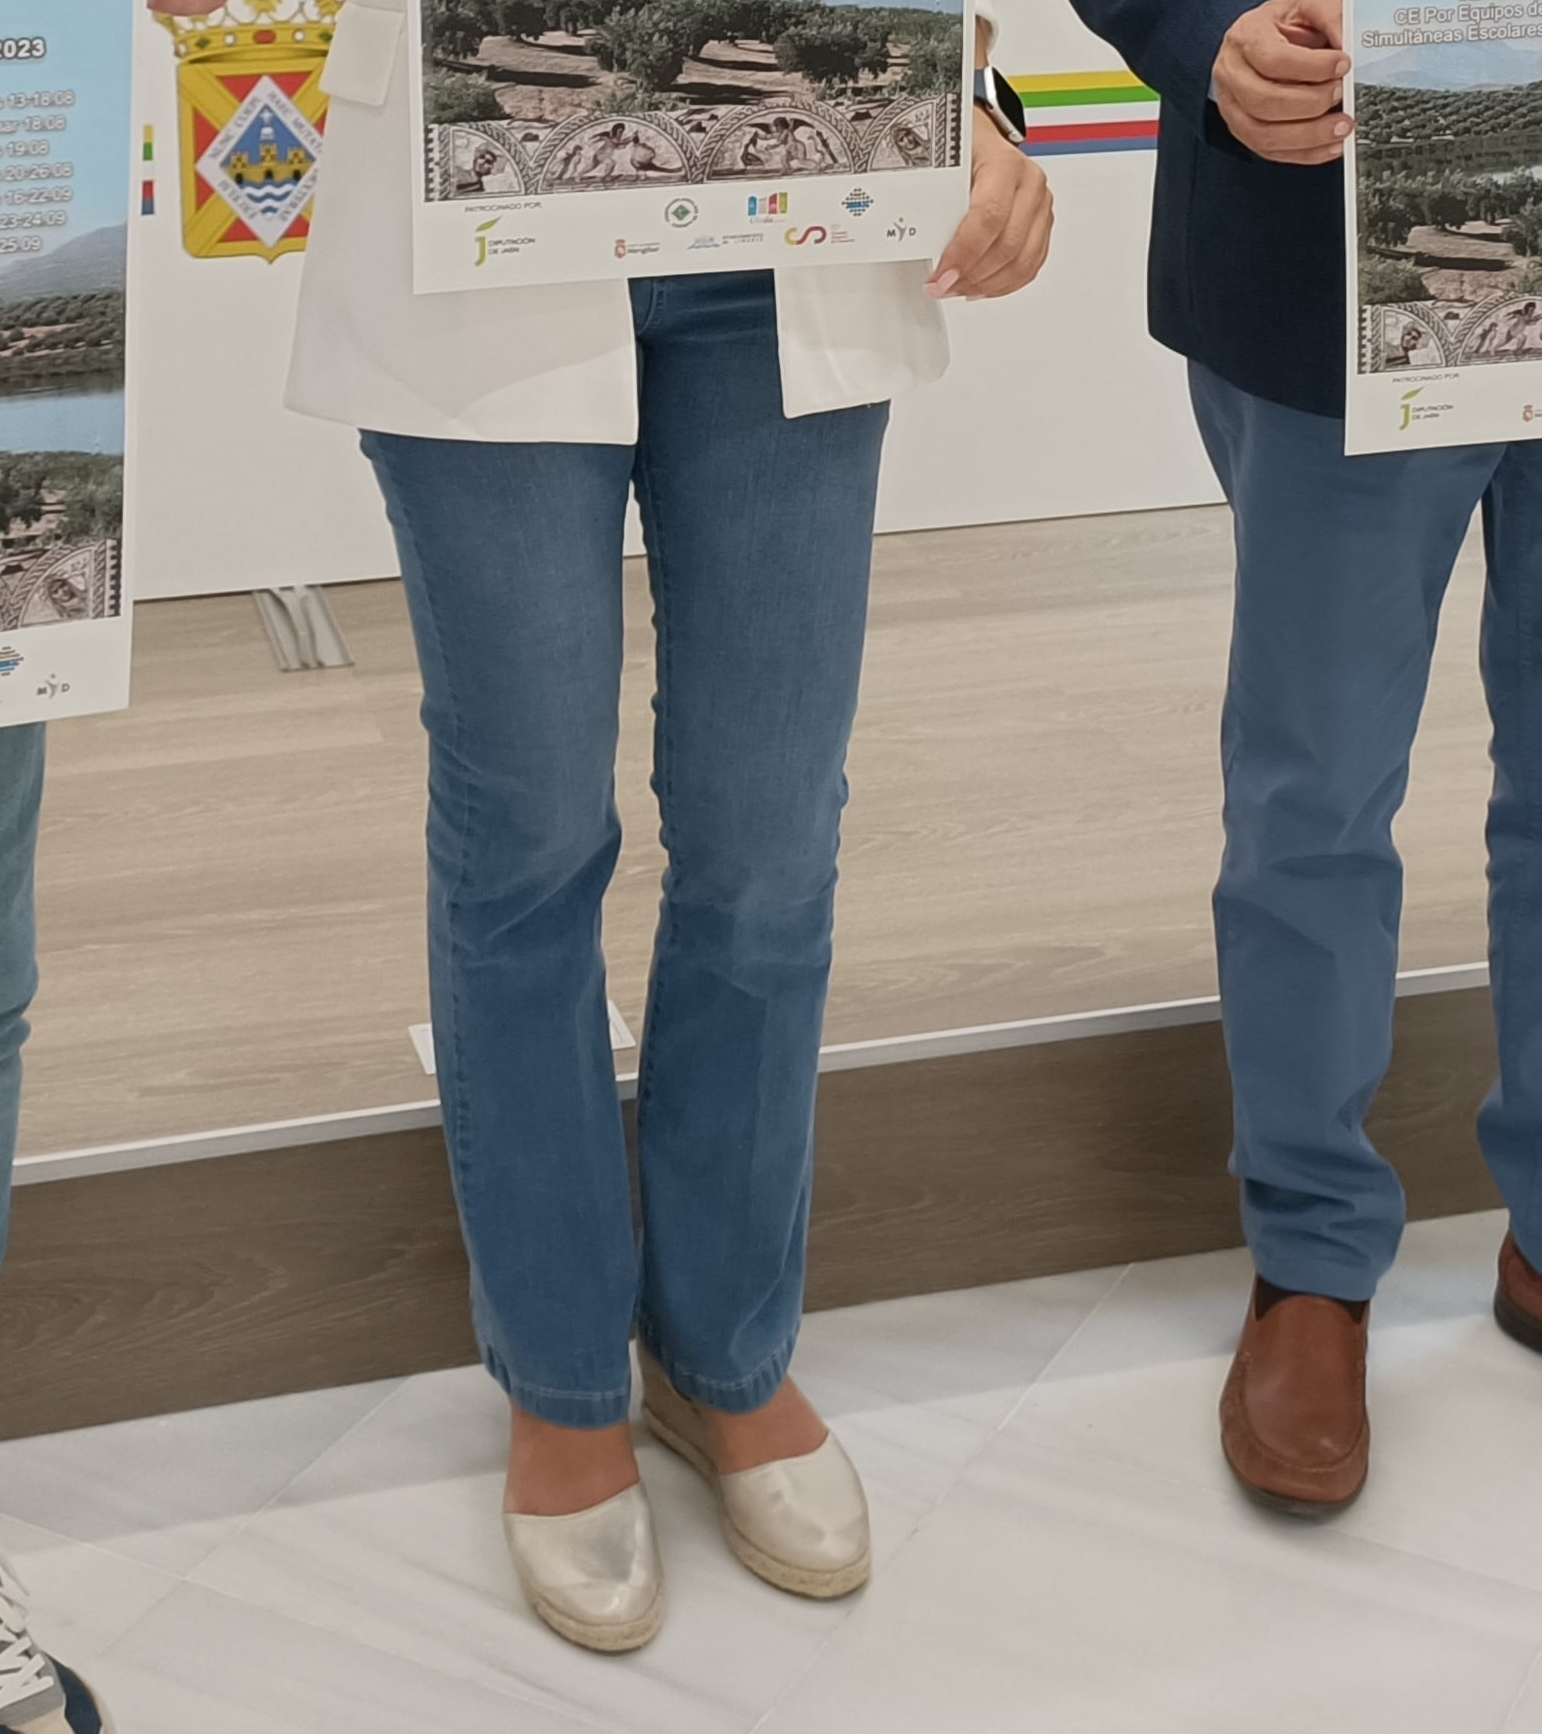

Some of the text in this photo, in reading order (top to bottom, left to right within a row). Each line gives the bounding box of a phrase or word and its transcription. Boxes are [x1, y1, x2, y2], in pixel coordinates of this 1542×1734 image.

[1395, 9, 1420, 26] CE
[1424, 7, 1454, 23] Por
[1457, 2, 1523, 24] Equipos
[1362, 28, 1462, 49] Simultáneas
